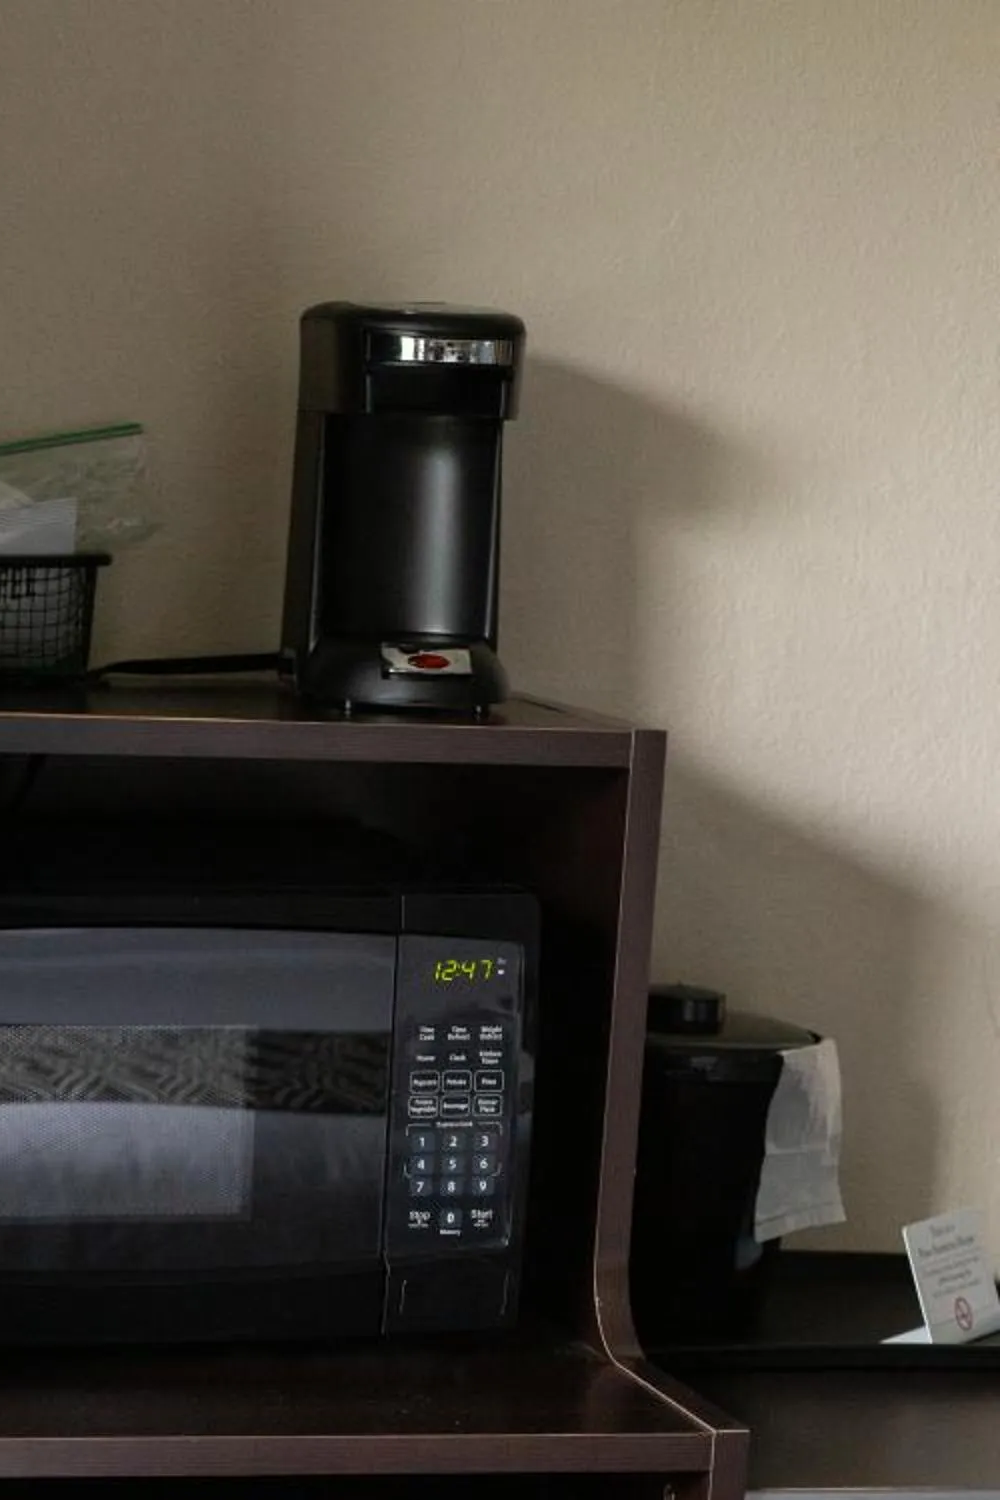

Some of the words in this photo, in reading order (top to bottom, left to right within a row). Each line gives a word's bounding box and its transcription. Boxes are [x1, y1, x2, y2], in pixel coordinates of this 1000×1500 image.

[435, 959, 493, 981] 12:47
[419, 1136, 425, 1148] 1
[449, 1135, 457, 1147] 2
[481, 1135, 489, 1147] 3
[417, 1159, 425, 1170] 4
[448, 1158, 457, 1170] 5
[480, 1158, 488, 1169] 6
[416, 1181, 425, 1193] 7
[447, 1181, 456, 1193] 8
[480, 1180, 487, 1191] 9
[447, 1211, 455, 1224] 0
